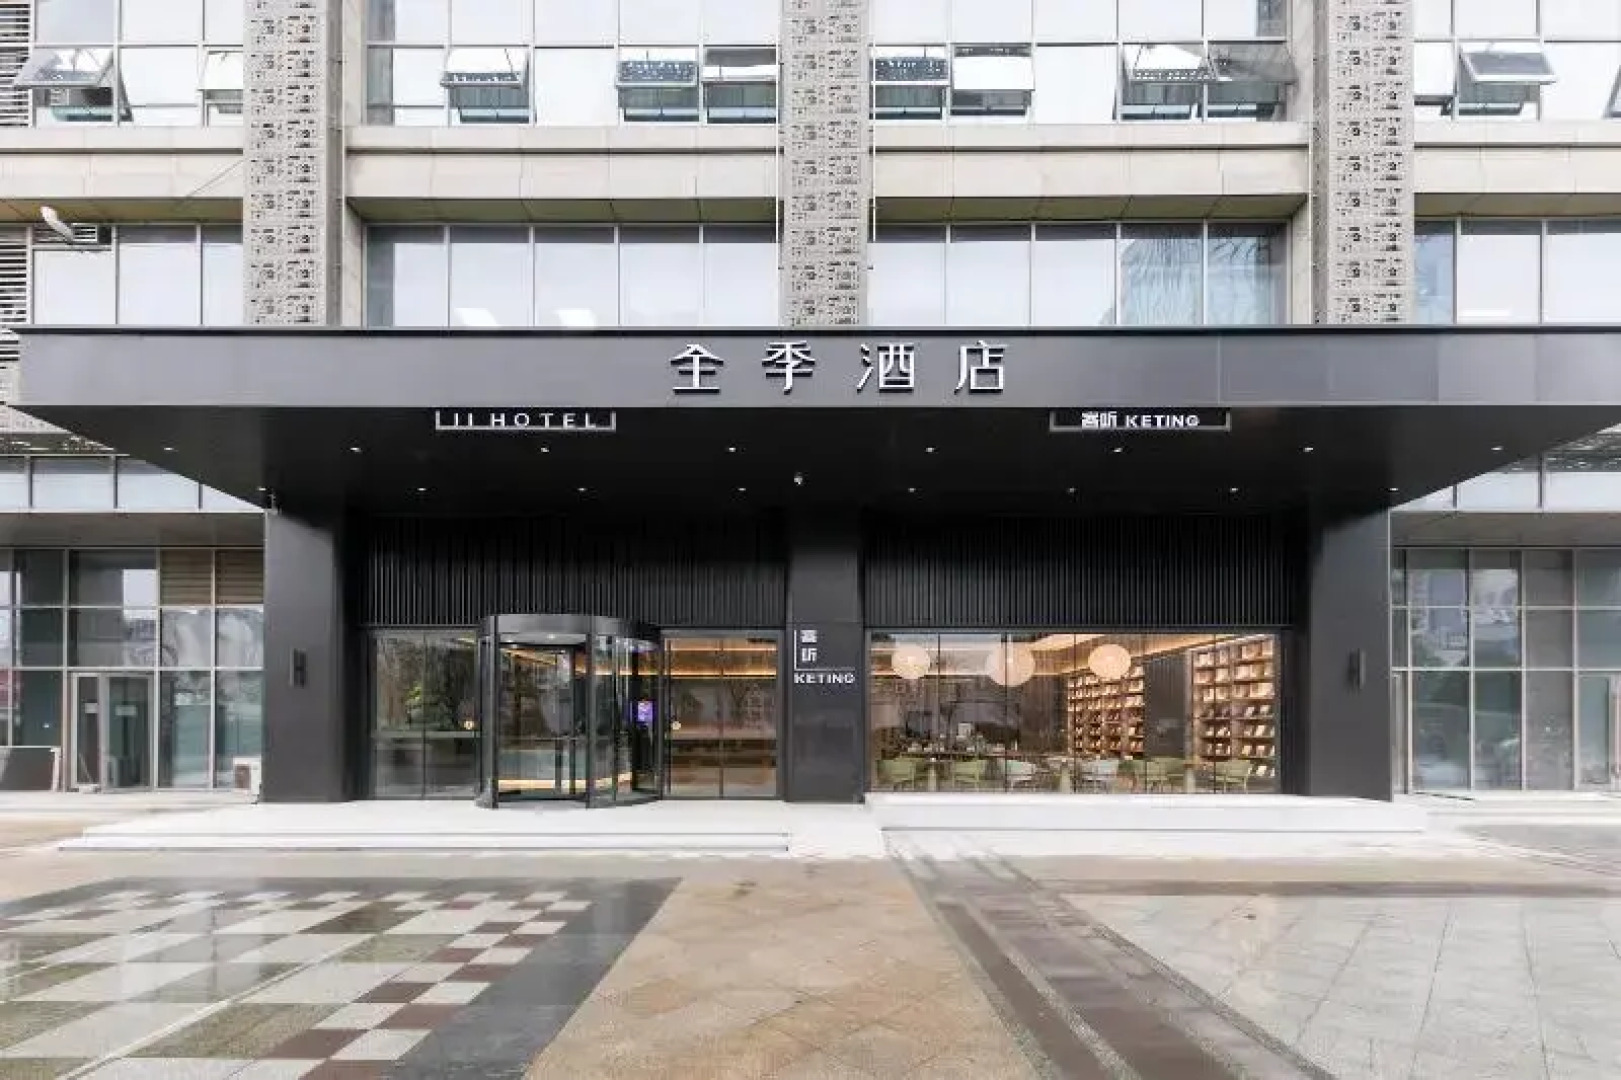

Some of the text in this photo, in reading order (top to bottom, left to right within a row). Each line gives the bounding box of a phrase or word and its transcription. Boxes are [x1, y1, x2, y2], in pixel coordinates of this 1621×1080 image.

[670, 339, 1007, 395] 全季酒店
[490, 412, 597, 428] HOTEL
[1125, 414, 1200, 428] KETING
[793, 672, 856, 684] KETING
